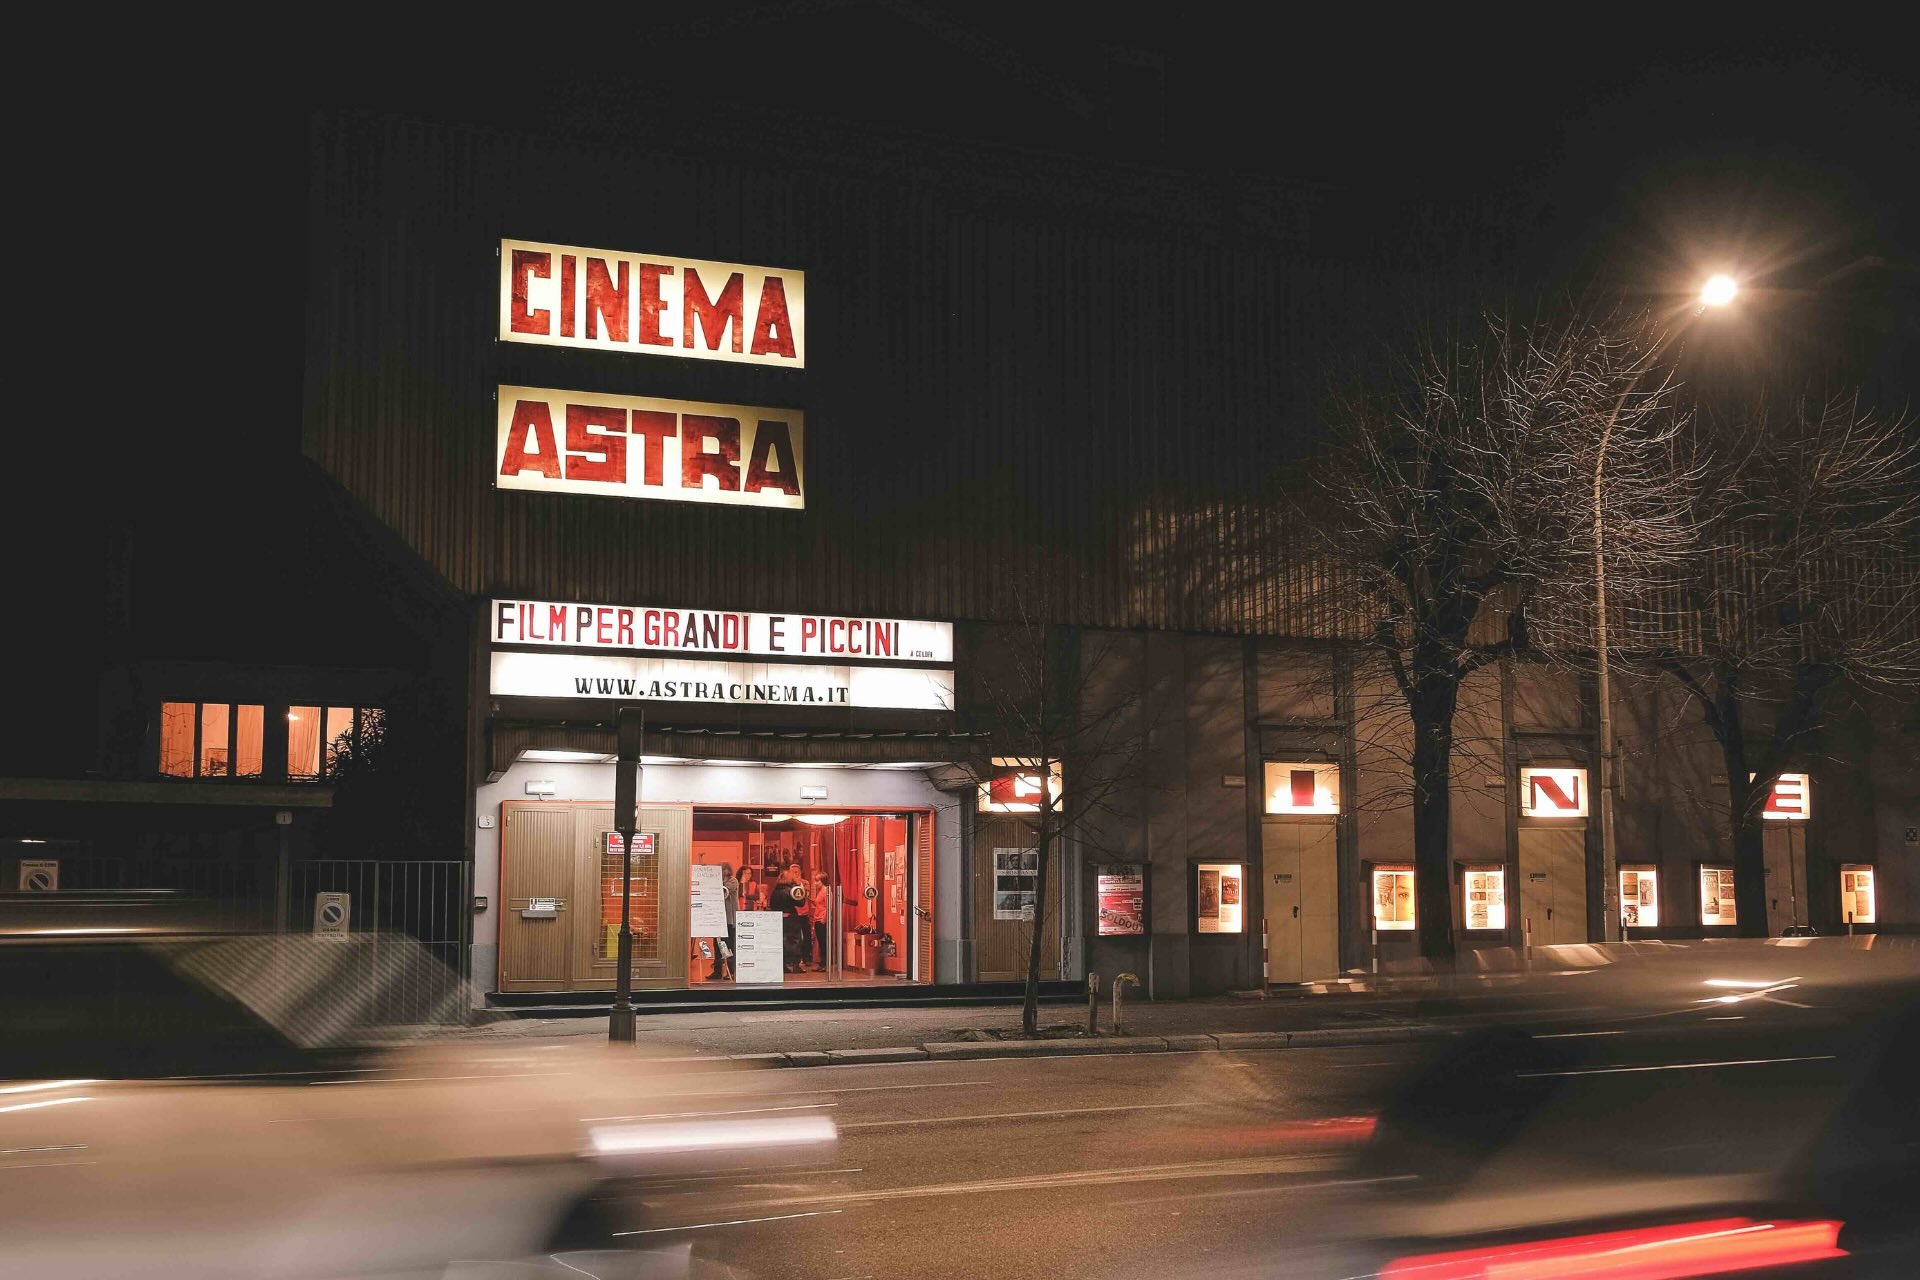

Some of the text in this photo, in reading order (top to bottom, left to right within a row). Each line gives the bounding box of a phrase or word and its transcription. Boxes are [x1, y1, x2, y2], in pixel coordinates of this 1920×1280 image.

[510, 248, 797, 359] CINEMA
[499, 399, 802, 496] ASTRA
[497, 602, 899, 657] FILM PER GRANDI E PICCINI
[574, 677, 849, 703] WWW.ASTRACINEMA.IT
[1529, 775, 1579, 810] N
